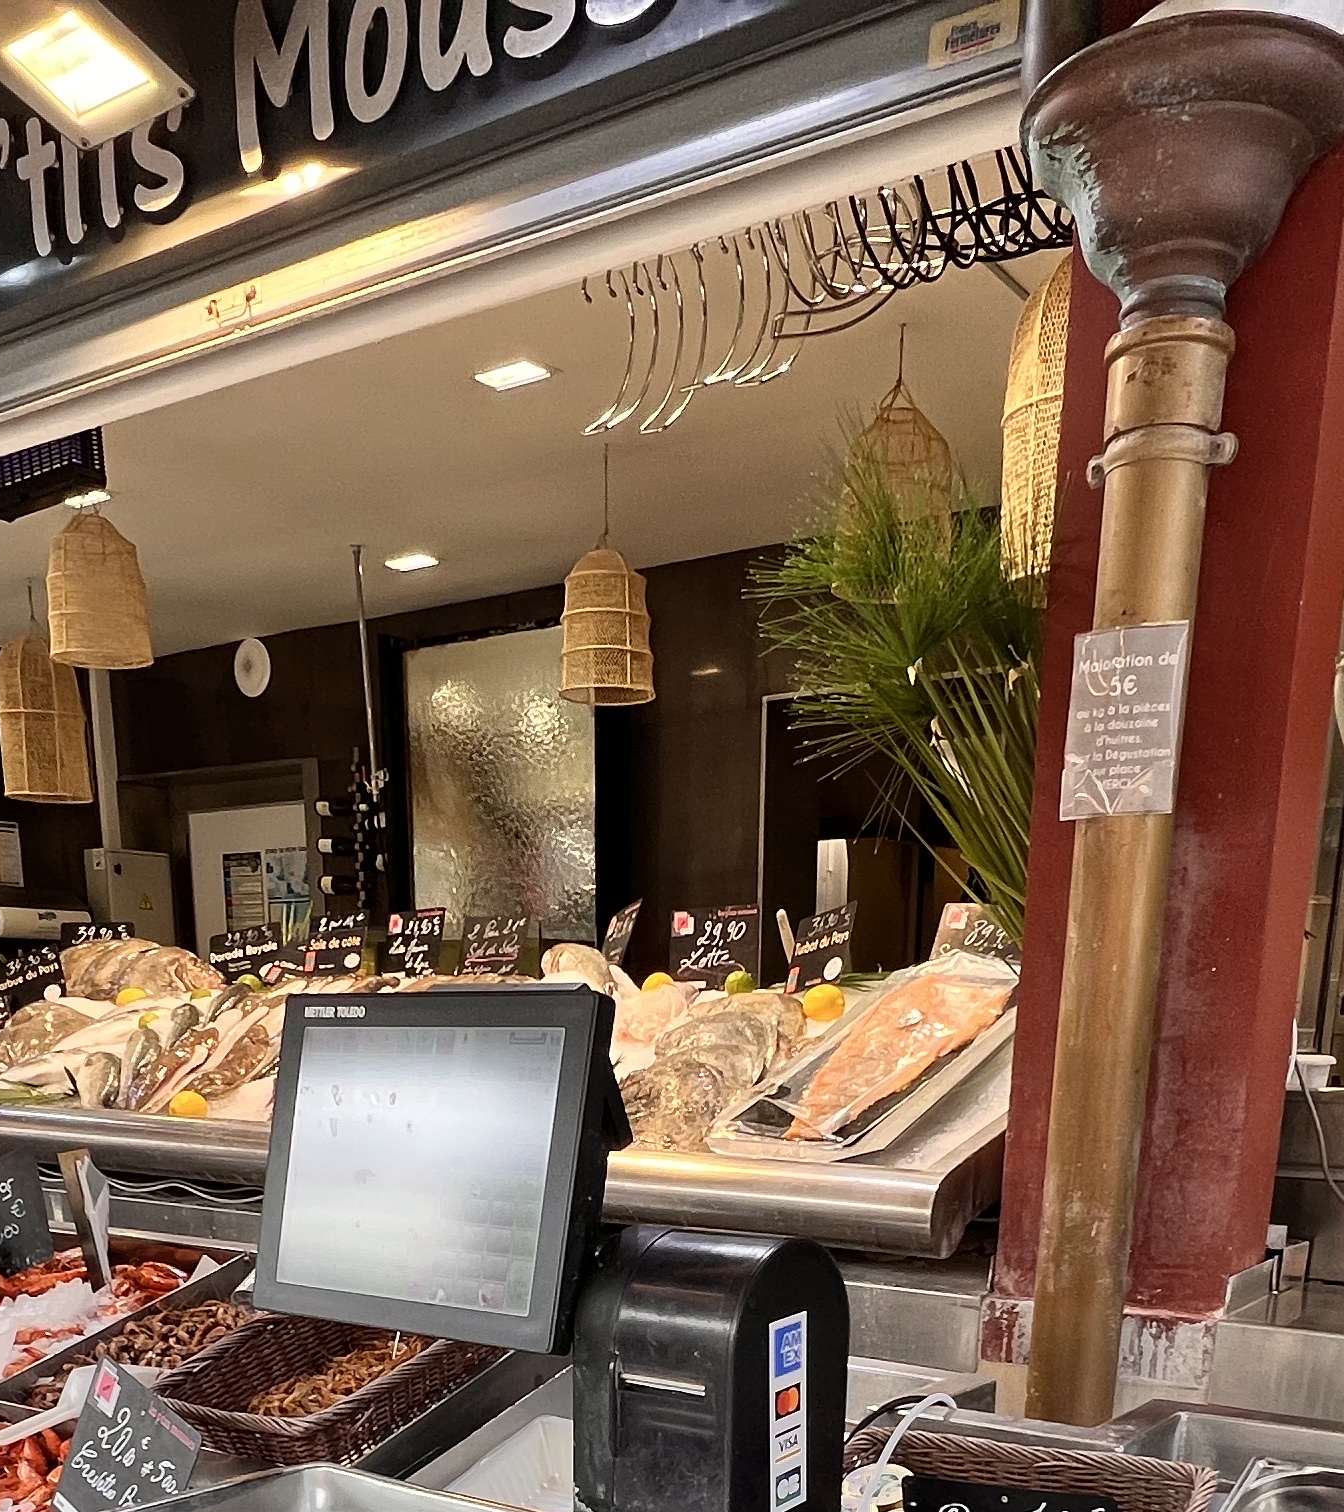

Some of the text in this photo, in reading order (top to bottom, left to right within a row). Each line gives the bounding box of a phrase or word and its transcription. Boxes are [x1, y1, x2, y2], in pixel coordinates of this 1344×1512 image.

[234, 0, 661, 174] Mous
[1078, 651, 1179, 674] Majoration de
[1108, 674, 1138, 697] 5€
[1118, 703, 1130, 715] la
[1093, 721, 1105, 732] la
[1107, 718, 1159, 731] douzaine
[1105, 748, 1172, 762] Dégustation
[1108, 763, 1142, 778] place
[696, 920, 748, 949] 29,90
[794, 928, 851, 957] Turbot du Pays
[245, 940, 279, 957] Royale
[679, 943, 737, 969] Lotte
[25, 969, 38, 982] du
[38, 962, 60, 977] Pays
[777, 1433, 799, 1453] VISA
[776, 1472, 800, 1500] CB
